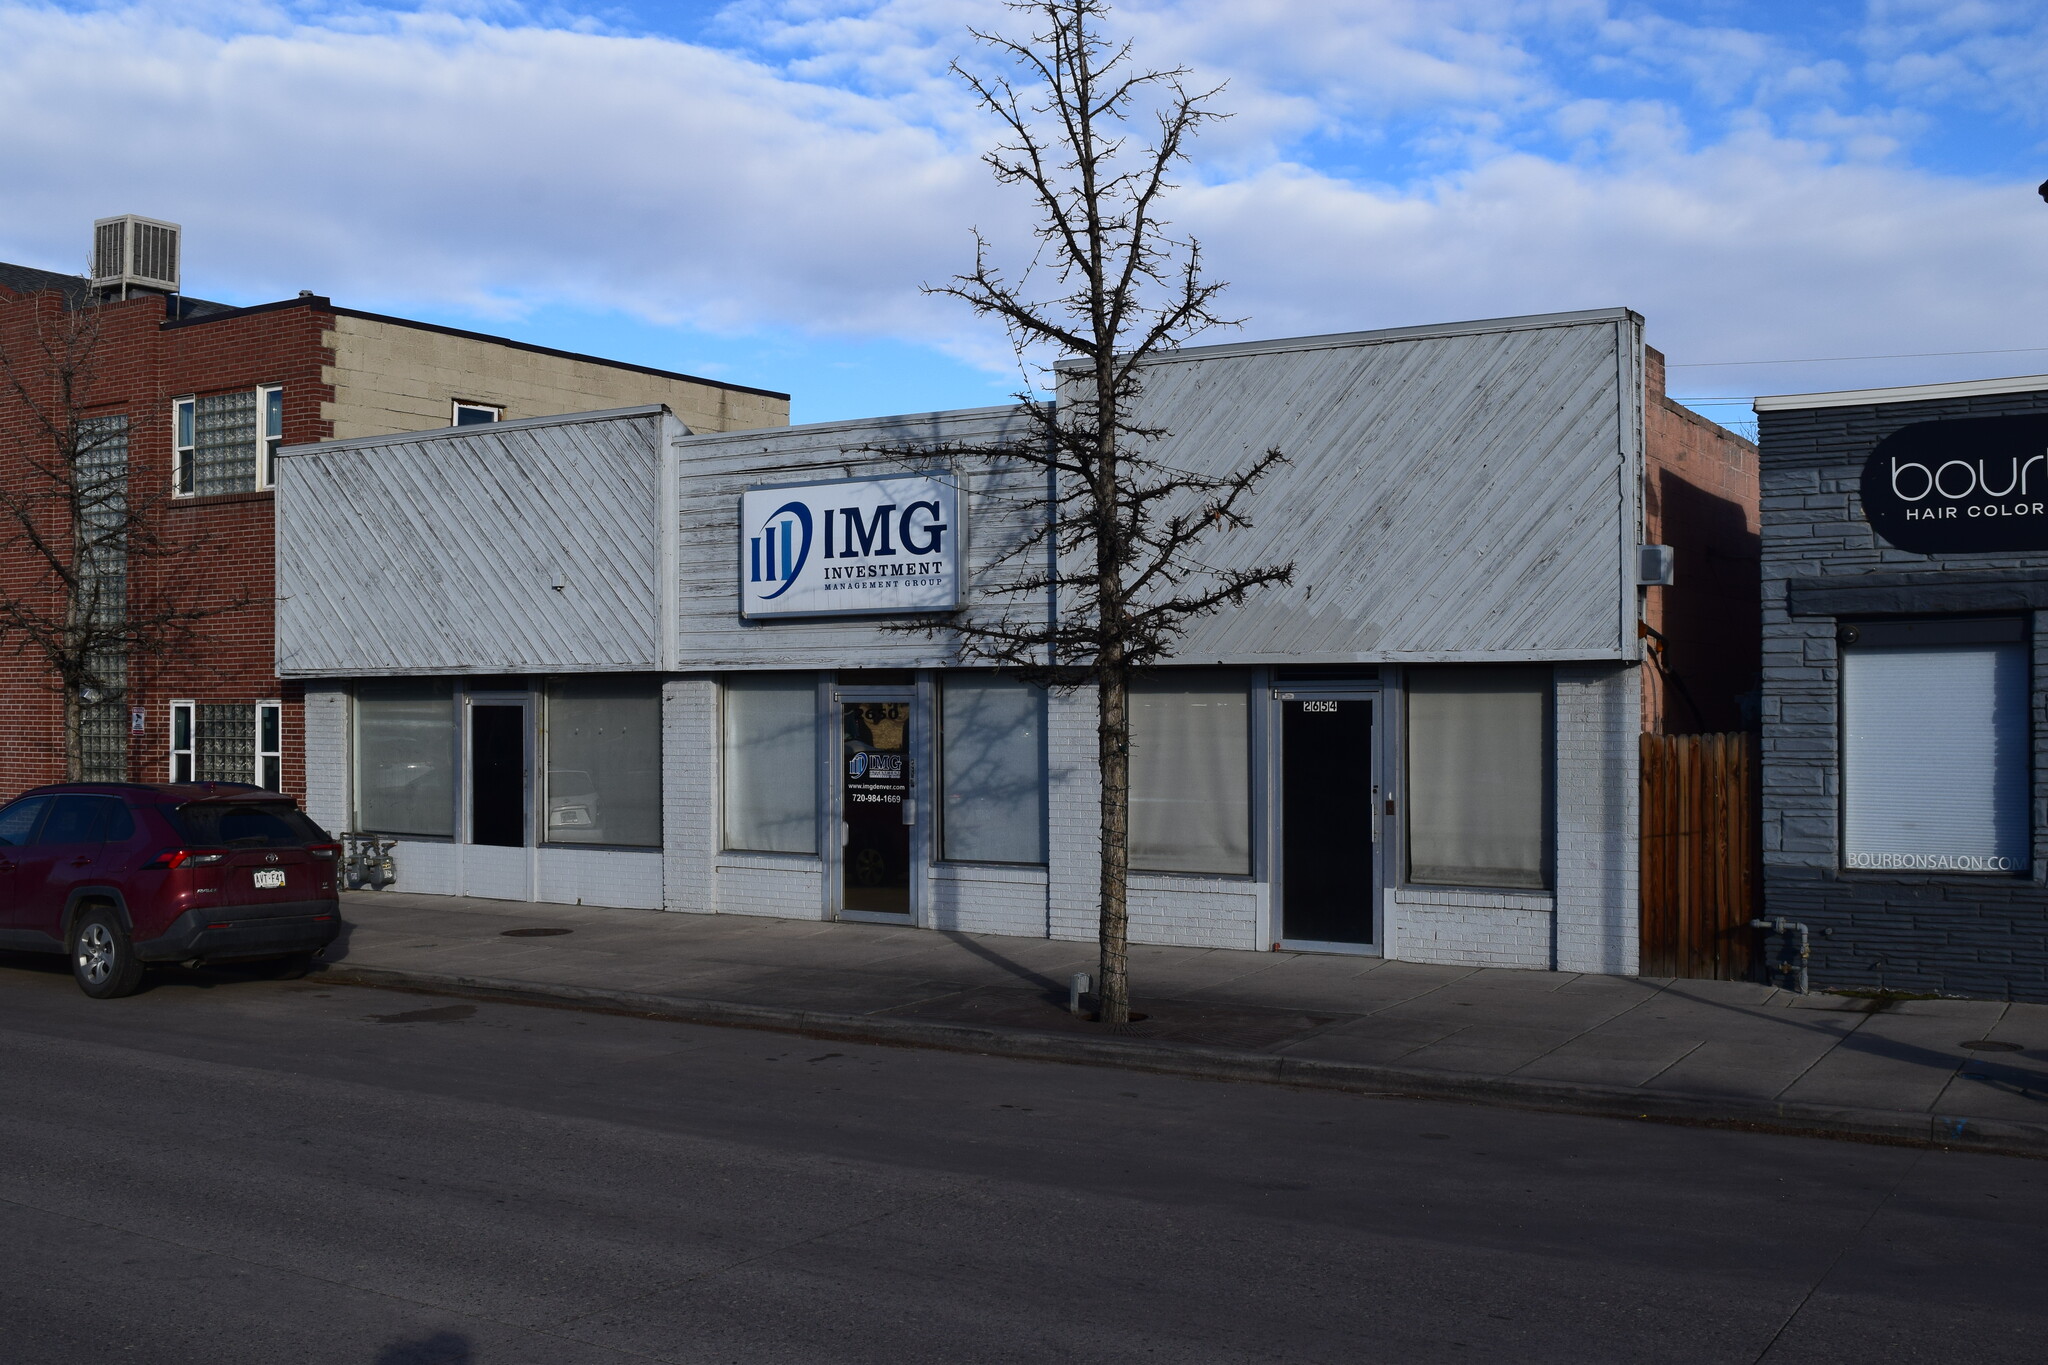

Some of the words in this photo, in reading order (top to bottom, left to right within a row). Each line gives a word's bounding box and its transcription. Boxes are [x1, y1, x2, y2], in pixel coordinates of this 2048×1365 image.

[1891, 447, 2048, 502] bour
[1906, 506, 1958, 521] HAIR
[1967, 502, 2044, 518] COLOR
[824, 500, 947, 559] IMG
[824, 561, 943, 580] INVESTMENT
[824, 580, 899, 591] MANAGEMENT
[904, 578, 943, 587] GROUP
[1303, 701, 1337, 712] 2654
[869, 754, 903, 771] IMG
[847, 782, 906, 791] www.imgdenver.com
[852, 793, 902, 804] 720-984-1669
